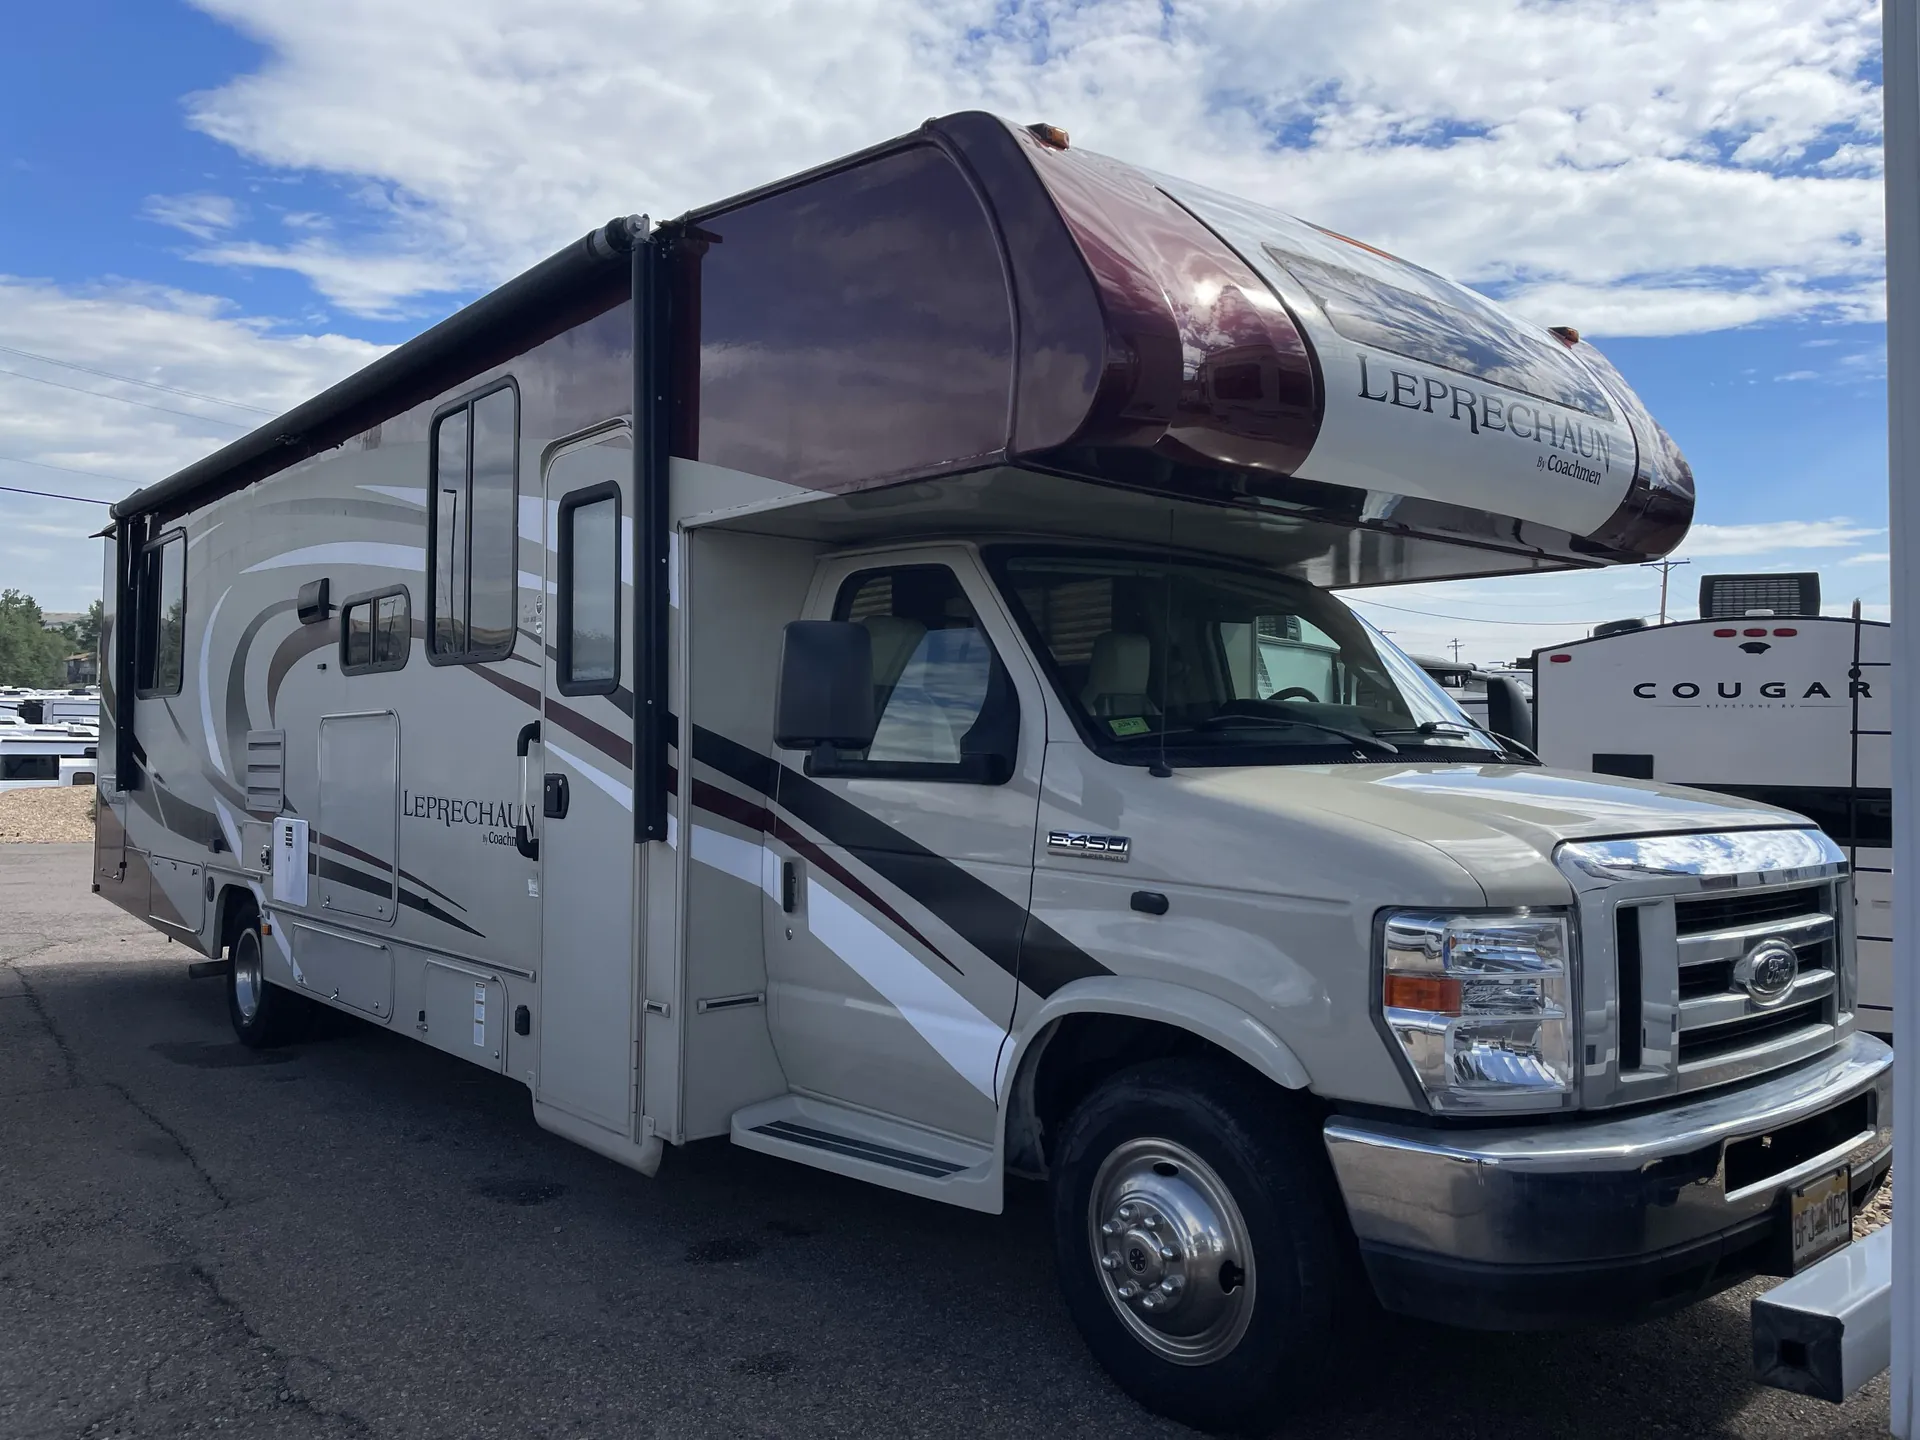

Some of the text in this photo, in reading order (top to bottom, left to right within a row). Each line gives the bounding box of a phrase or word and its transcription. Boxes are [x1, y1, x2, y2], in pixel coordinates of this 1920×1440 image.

[1356, 353, 1612, 473] LEPRECHAUN
[1537, 454, 1601, 486] By Coachmen
[1633, 682, 1873, 699] COUGAR
[403, 789, 536, 837] LEPRECHAUN
